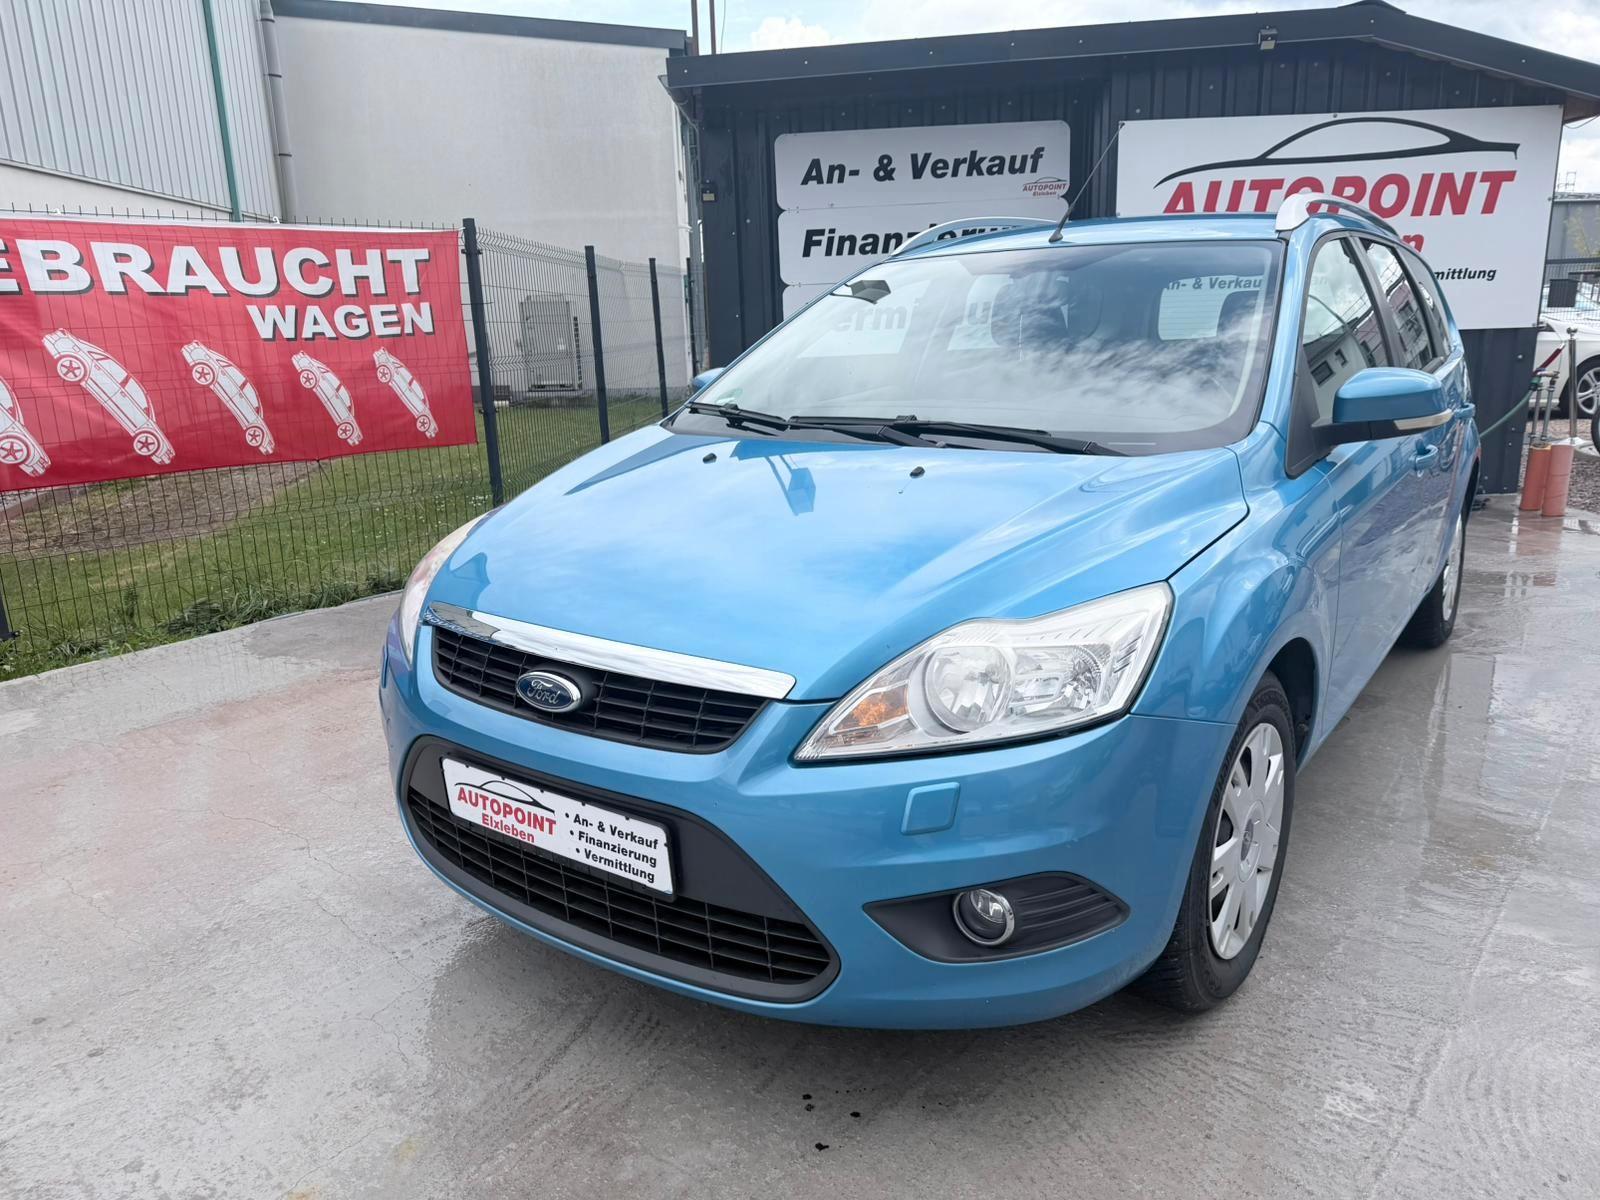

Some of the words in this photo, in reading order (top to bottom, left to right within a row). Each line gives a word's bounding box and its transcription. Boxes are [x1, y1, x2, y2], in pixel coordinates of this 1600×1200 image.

[800, 158, 860, 186] An-
[873, 154, 896, 182] &
[909, 147, 1045, 180] Verkauf
[1022, 183, 1067, 192] AUTOPOINT
[1209, 276, 1263, 289] Verkau
[246, 302, 435, 341] WAGEN
[526, 679, 561, 704] Ford
[457, 786, 557, 836] AUTOPOINT
[481, 812, 535, 844] Elxleben
[573, 812, 594, 828] An-
[597, 820, 606, 833] &
[609, 823, 659, 850] Verkauf
[578, 831, 658, 868] Finanzierung
[584, 848, 655, 883] Vermittlung
